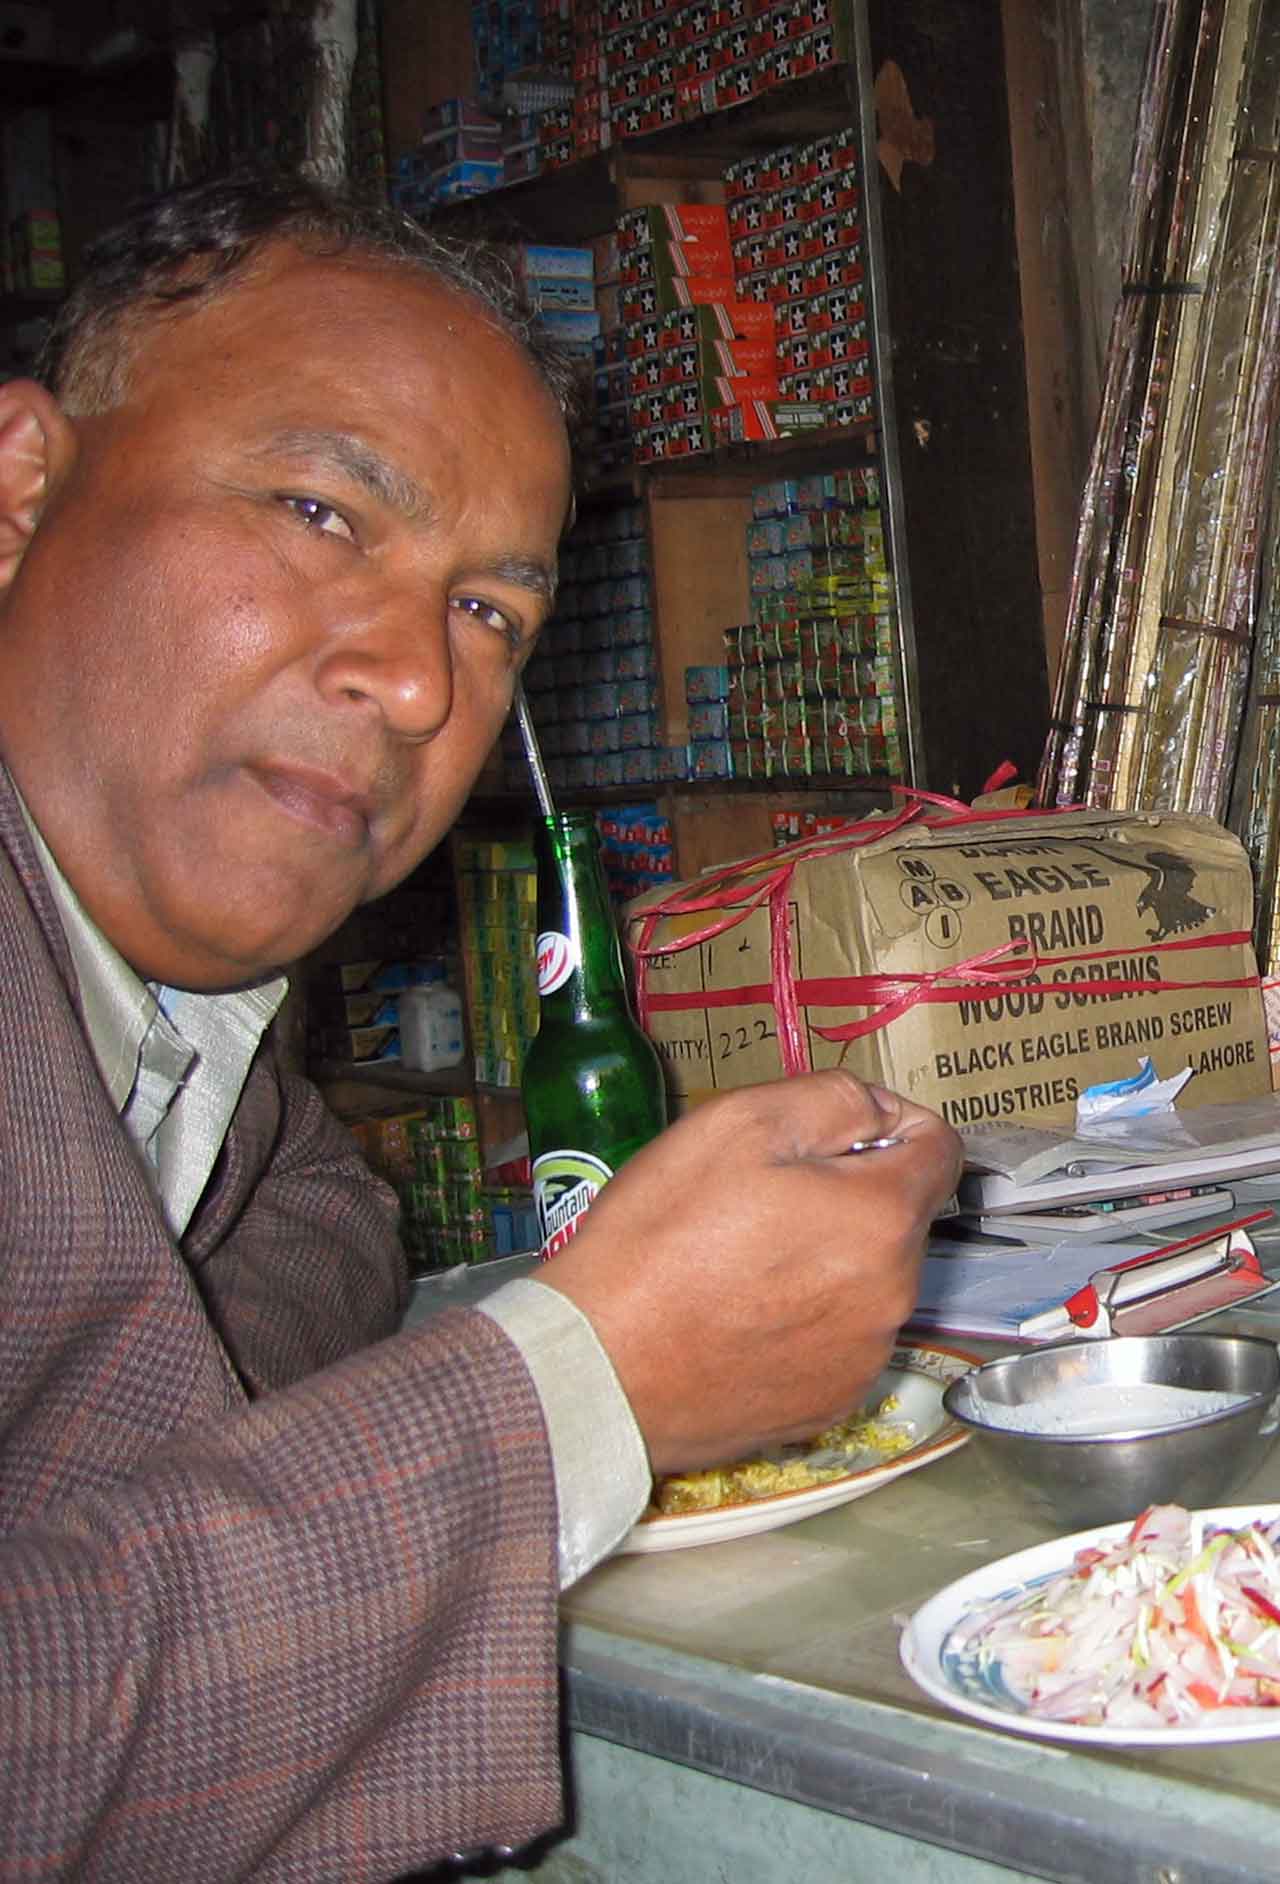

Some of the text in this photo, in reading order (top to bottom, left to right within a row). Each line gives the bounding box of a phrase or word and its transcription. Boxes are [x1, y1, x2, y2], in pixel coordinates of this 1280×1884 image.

[904, 860, 930, 877] M
[974, 863, 1111, 900] EAGLE
[912, 884, 964, 907] A B
[1008, 904, 1105, 953] BRAND
[719, 1020, 777, 1059] 222
[935, 1043, 1015, 1079] BLACK
[1021, 1029, 1090, 1063] EAGLE
[1096, 1013, 1165, 1050] BRAND
[1171, 1001, 1232, 1037] SCREW
[942, 1077, 1078, 1123] INDUSTRIES
[1188, 1040, 1255, 1076] LAHORE
